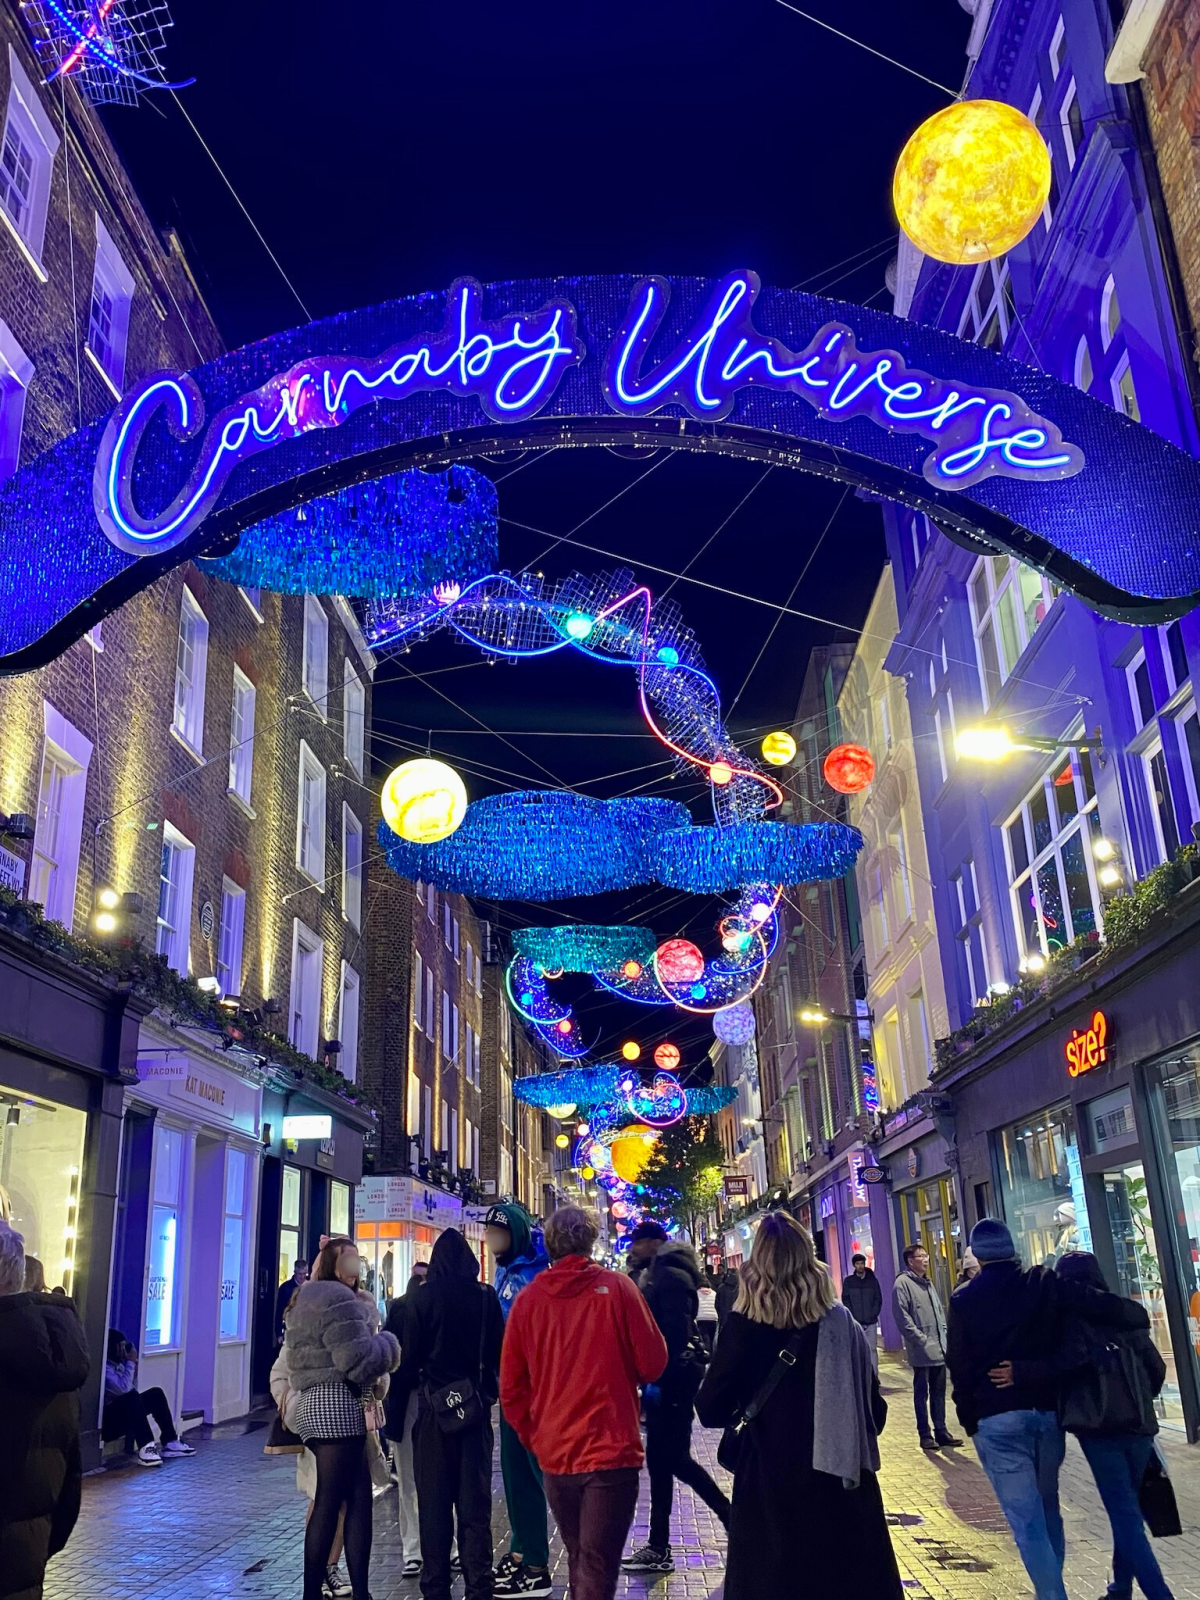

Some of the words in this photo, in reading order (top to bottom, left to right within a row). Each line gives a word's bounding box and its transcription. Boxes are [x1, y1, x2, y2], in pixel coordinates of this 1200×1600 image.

[107, 286, 574, 543] Carnaby
[614, 278, 1072, 478] Universe
[1066, 1011, 1107, 1078] size?
[146, 1067, 184, 1077] MACONIE
[185, 1075, 198, 1095] KAT
[198, 1080, 226, 1106] MACONIE
[148, 1282, 166, 1301] SALE
[220, 1285, 235, 1301] SALE
